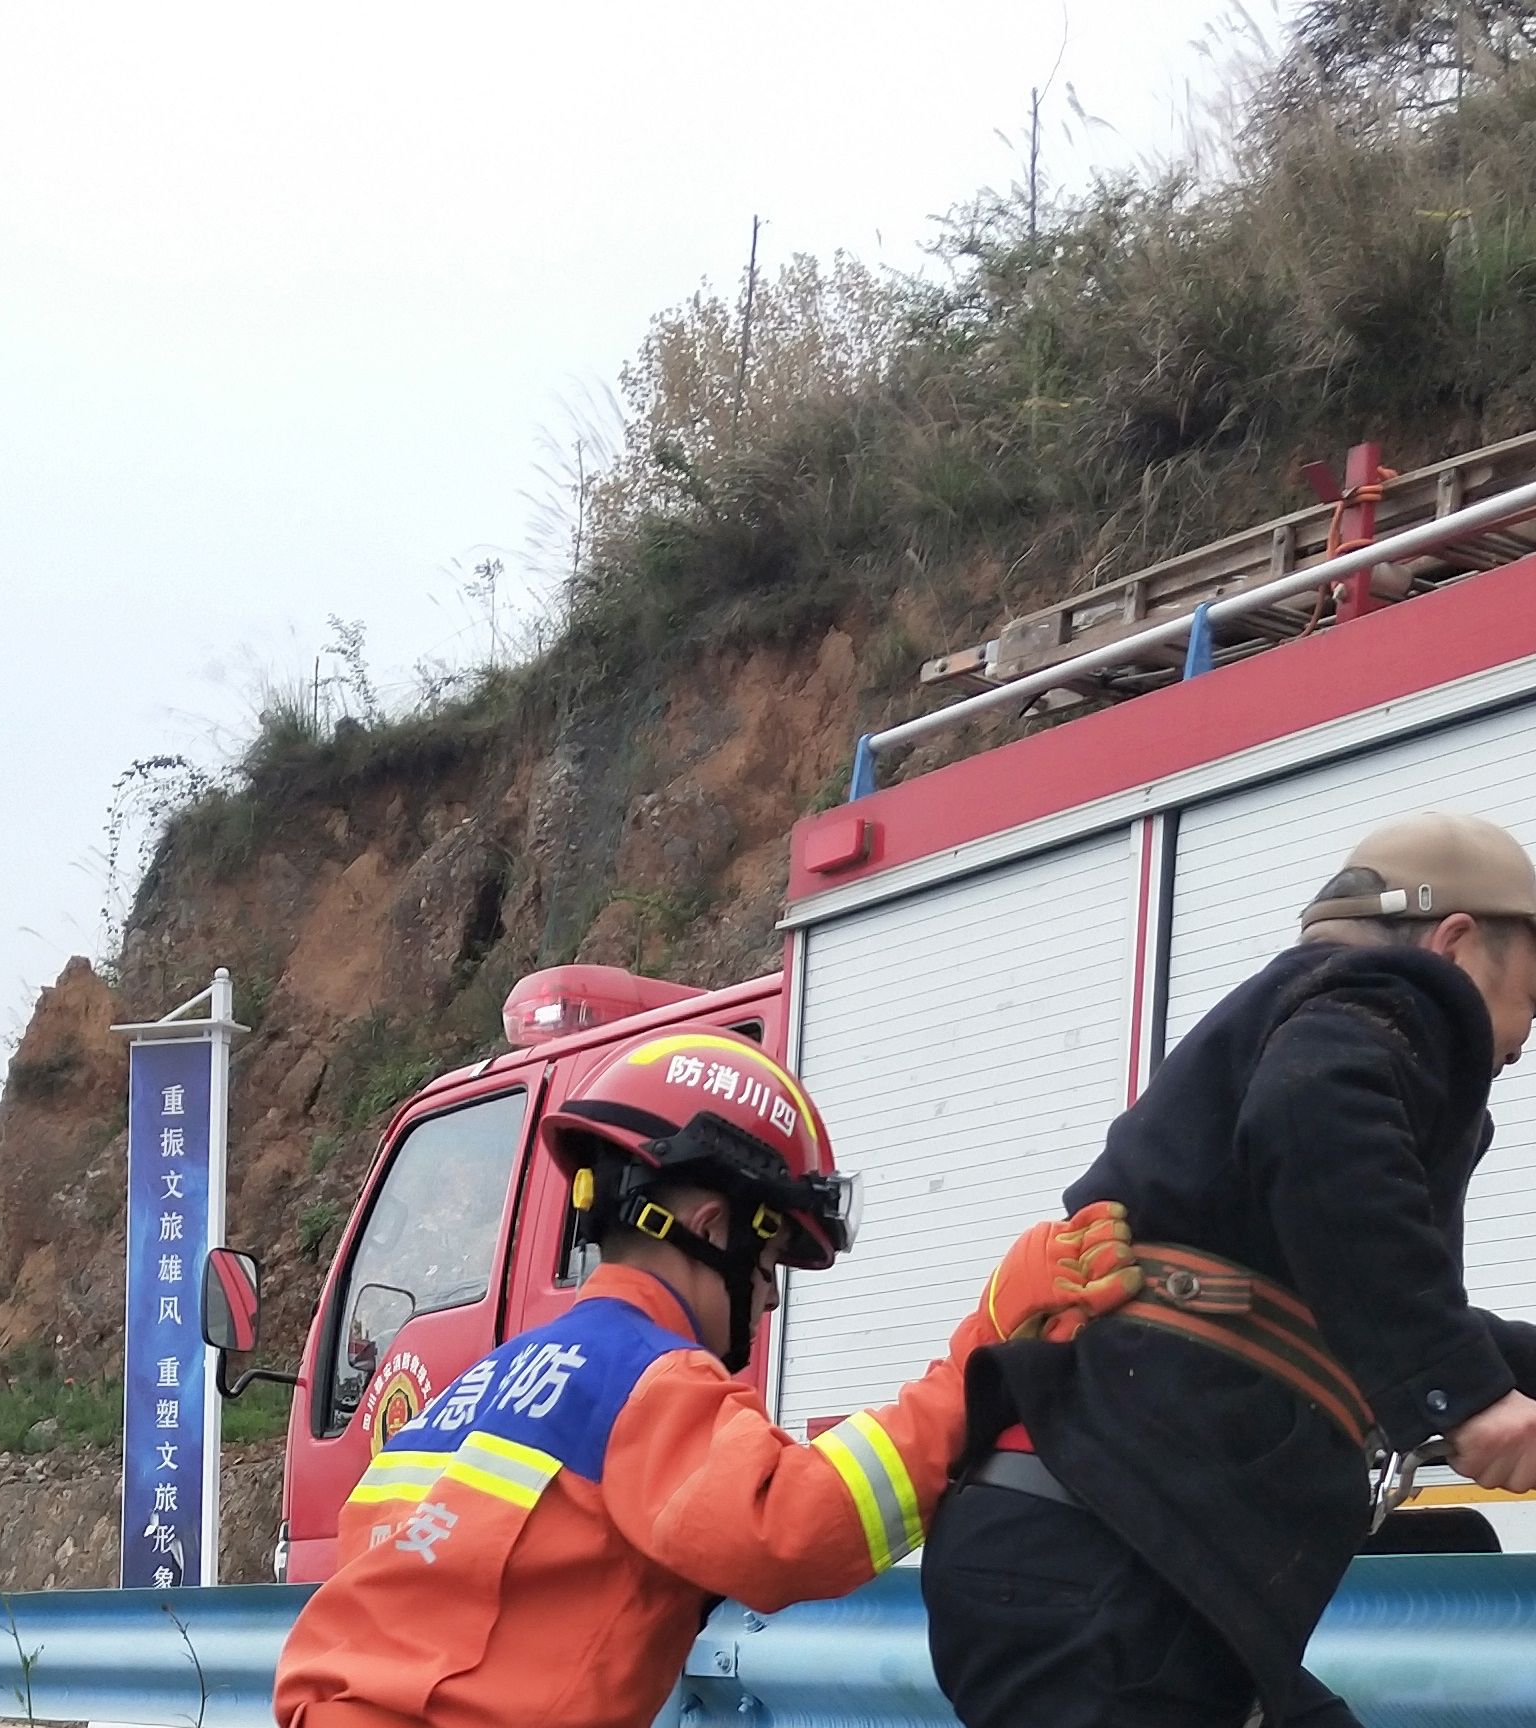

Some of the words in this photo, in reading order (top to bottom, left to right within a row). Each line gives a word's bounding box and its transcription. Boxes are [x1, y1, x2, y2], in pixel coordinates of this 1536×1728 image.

[157, 1084, 185, 1326] 重振文旅雄风
